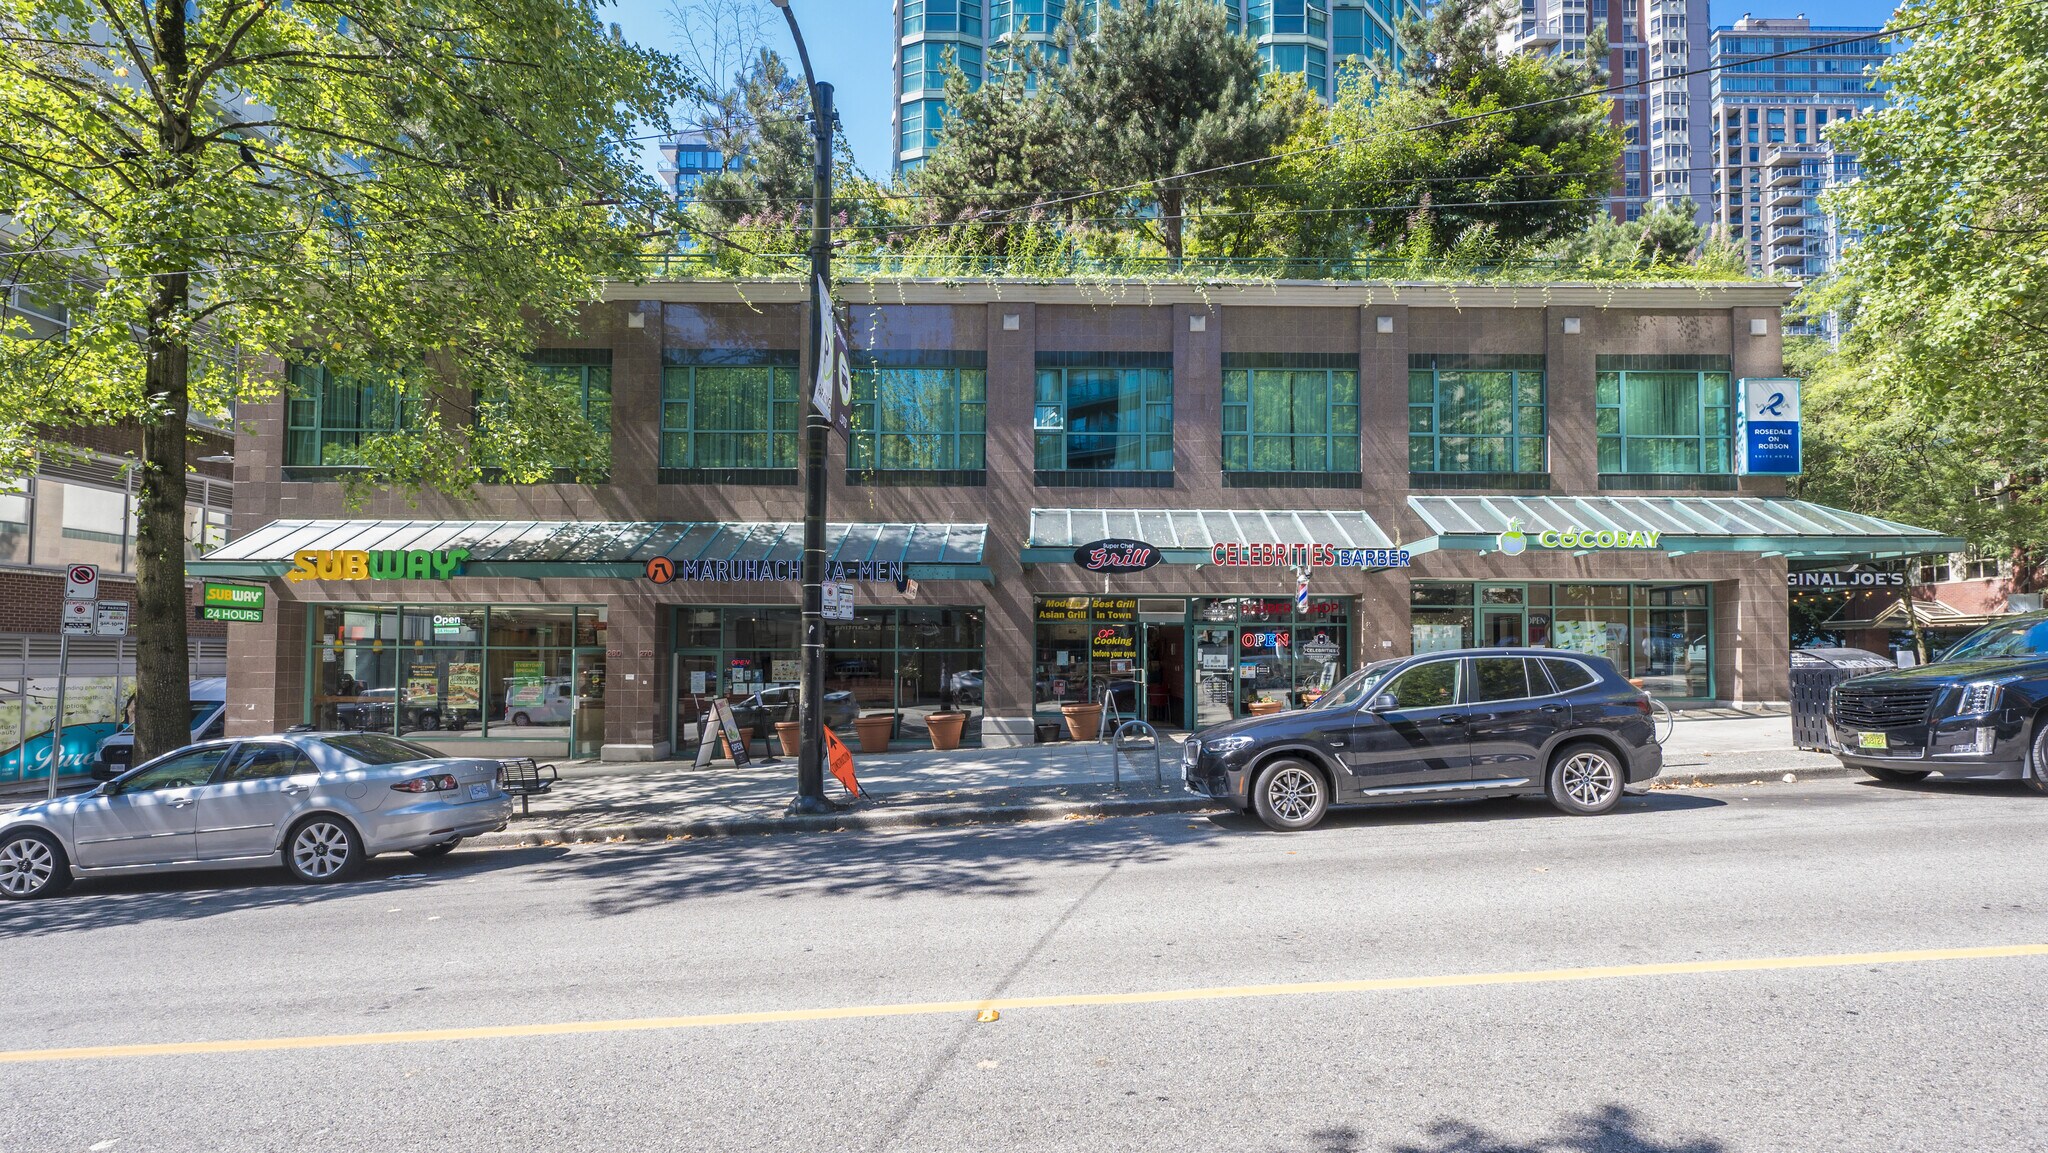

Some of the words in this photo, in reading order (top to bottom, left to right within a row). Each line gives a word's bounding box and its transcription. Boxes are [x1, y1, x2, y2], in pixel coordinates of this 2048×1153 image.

[1539, 526, 1662, 548] COCOBAY
[1087, 548, 1151, 570] Grill
[1212, 543, 1335, 567] CELEBRITIES
[1339, 549, 1411, 567] BARBER
[285, 547, 471, 583] SUBWAY
[683, 559, 802, 582] MARUHACH
[1850, 572, 1904, 586] JOE'S
[207, 588, 263, 602] SUBWAY
[1092, 600, 1115, 608] Best
[1116, 600, 1136, 608] Grill
[207, 609, 221, 619] 24
[222, 610, 260, 620] HOURS
[433, 615, 461, 626] Open
[1039, 611, 1065, 619] Asian
[1067, 611, 1087, 619] Grill
[1096, 611, 1106, 619] in
[1108, 611, 1132, 619] Town
[1093, 637, 1133, 647] Cooking
[1241, 633, 1290, 648] OPEN
[1092, 650, 1109, 658] before
